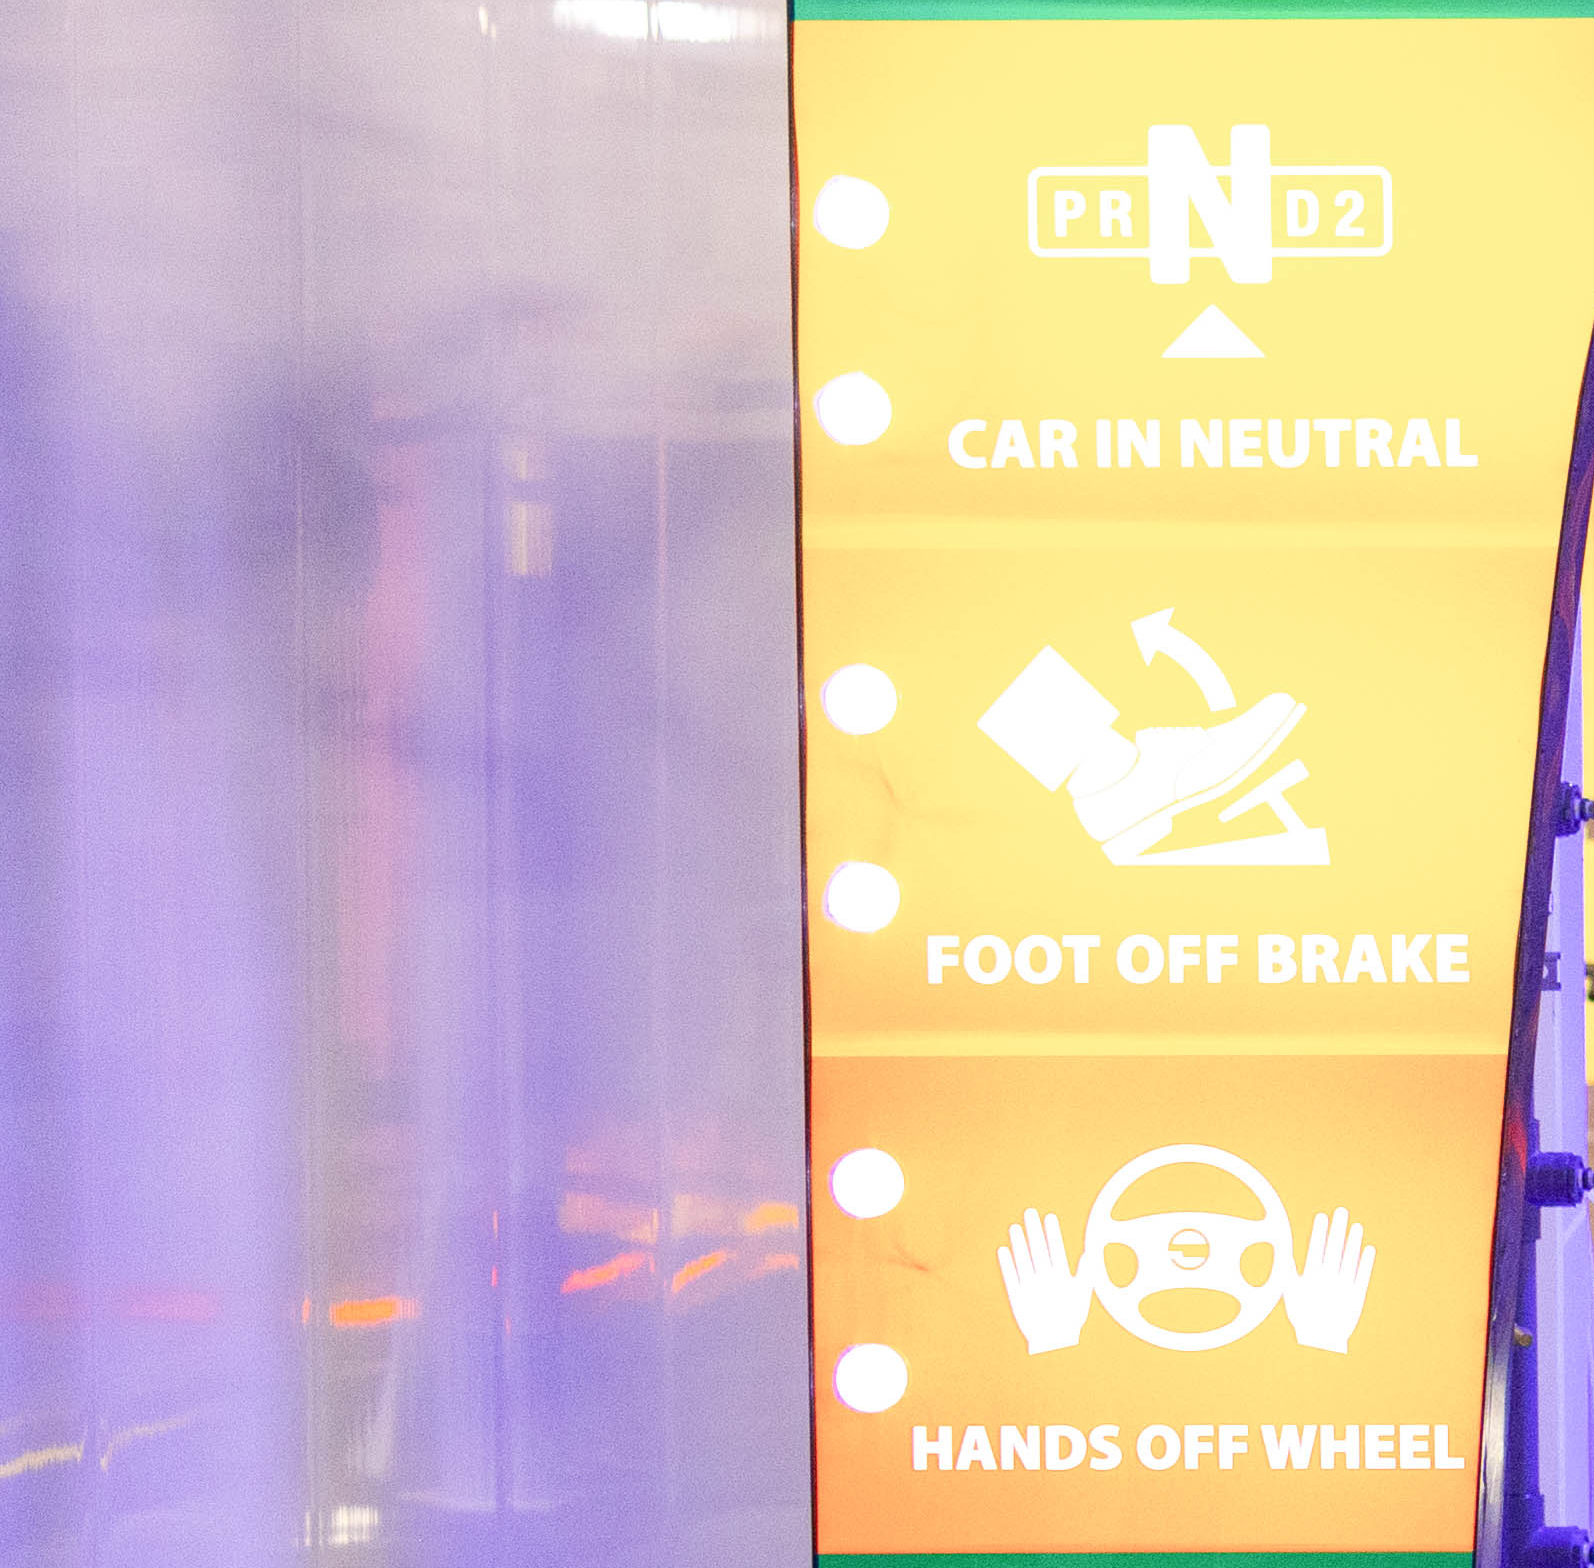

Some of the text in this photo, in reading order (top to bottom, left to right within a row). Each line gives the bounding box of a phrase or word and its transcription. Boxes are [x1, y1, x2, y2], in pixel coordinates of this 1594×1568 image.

[946, 417, 1480, 470] CAR IN NEUTRAL
[926, 932, 1471, 986] FOOT OFF BRAKE
[911, 1423, 1466, 1472] HANDS OFF WHEEL
